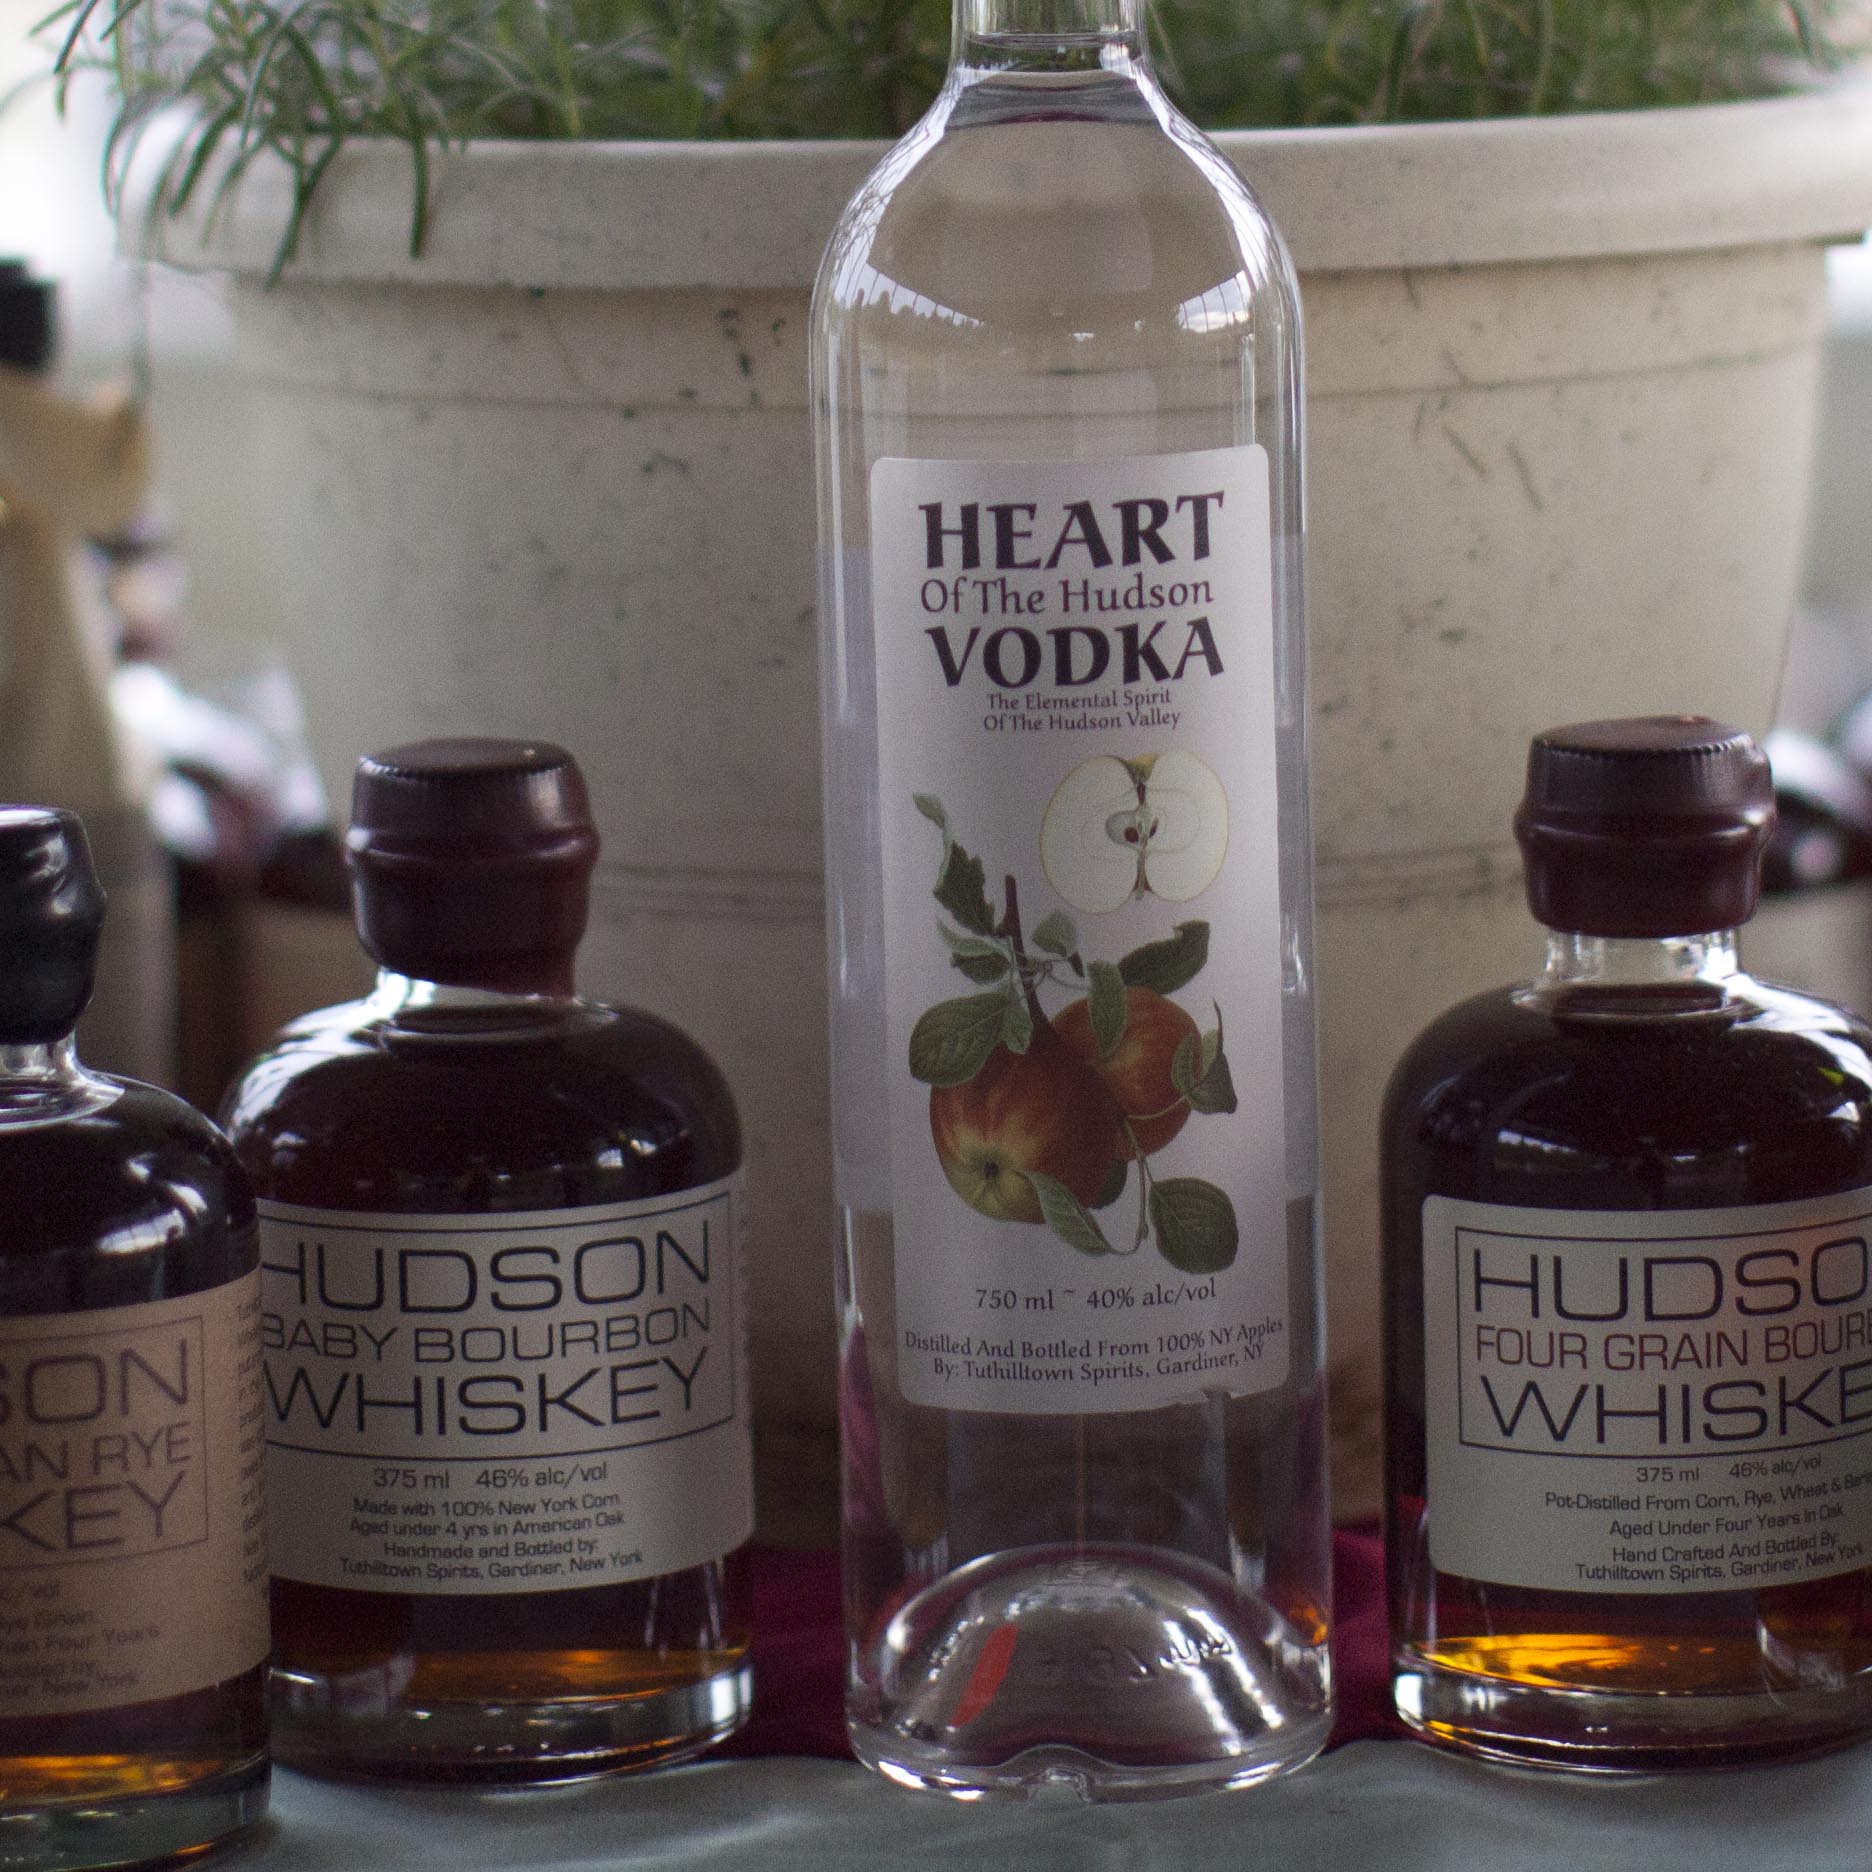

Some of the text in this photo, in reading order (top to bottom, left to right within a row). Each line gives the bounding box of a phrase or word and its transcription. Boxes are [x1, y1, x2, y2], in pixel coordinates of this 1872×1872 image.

[918, 490, 1225, 571] HEART
[920, 573, 1214, 614] Of The Hudson
[924, 616, 1225, 689] VODKA
[987, 688, 1171, 710] The Elemental Spirit
[983, 709, 1181, 730] Of The Hudson Valley
[261, 1219, 709, 1314] HUDSON
[975, 1277, 1218, 1311] 750 ml 40% alc/vol
[262, 1296, 710, 1364] BABY BOURBON
[904, 1315, 1284, 1359] Distilled And Bottled From 100% NY Apples
[963, 1359, 1074, 1381] Tuthilltown
[1156, 1348, 1240, 1377] Gardiner,
[1242, 1341, 1266, 1363] NY
[1476, 1324, 1588, 1370] FOUR
[1603, 1330, 1748, 1371] GRAIN
[262, 1345, 708, 1437] WHISKEY
[91, 1420, 192, 1476] RYE
[373, 1461, 609, 1490] 375 ml 46% alc/vol
[1636, 1452, 1822, 1483] 375 ml 46% alc/vol
[353, 1492, 620, 1517] Made with 100% New York Corn
[1545, 1491, 1641, 1511] Pot-Distilled
[1645, 1495, 1690, 1511] From
[1780, 1478, 1828, 1502] Wheat
[350, 1517, 389, 1537] Aged
[393, 1521, 441, 1537] under
[445, 1521, 458, 1536] 4
[493, 1521, 508, 1536] in
[512, 1514, 592, 1536] American
[595, 1510, 625, 1529] Oak
[1609, 1520, 1654, 1539] Aged
[1658, 1519, 1711, 1536] Under
[1716, 1517, 1753, 1534] Four
[1757, 1510, 1801, 1530] Years
[1819, 1503, 1845, 1521] Oak
[384, 1542, 474, 1560] Handmade
[478, 1541, 510, 1559] and
[514, 1539, 574, 1558] Bottled
[569, 1556, 605, 1574] New
[609, 1548, 644, 1566] York
[1612, 1546, 1657, 1563] Hand
[1661, 1544, 1725, 1562] Crafted
[1729, 1541, 1762, 1559] And
[1766, 1534, 1818, 1556] Bottled
[1576, 1563, 1665, 1582] Tuthilltown
[1805, 1550, 1835, 1568] New
